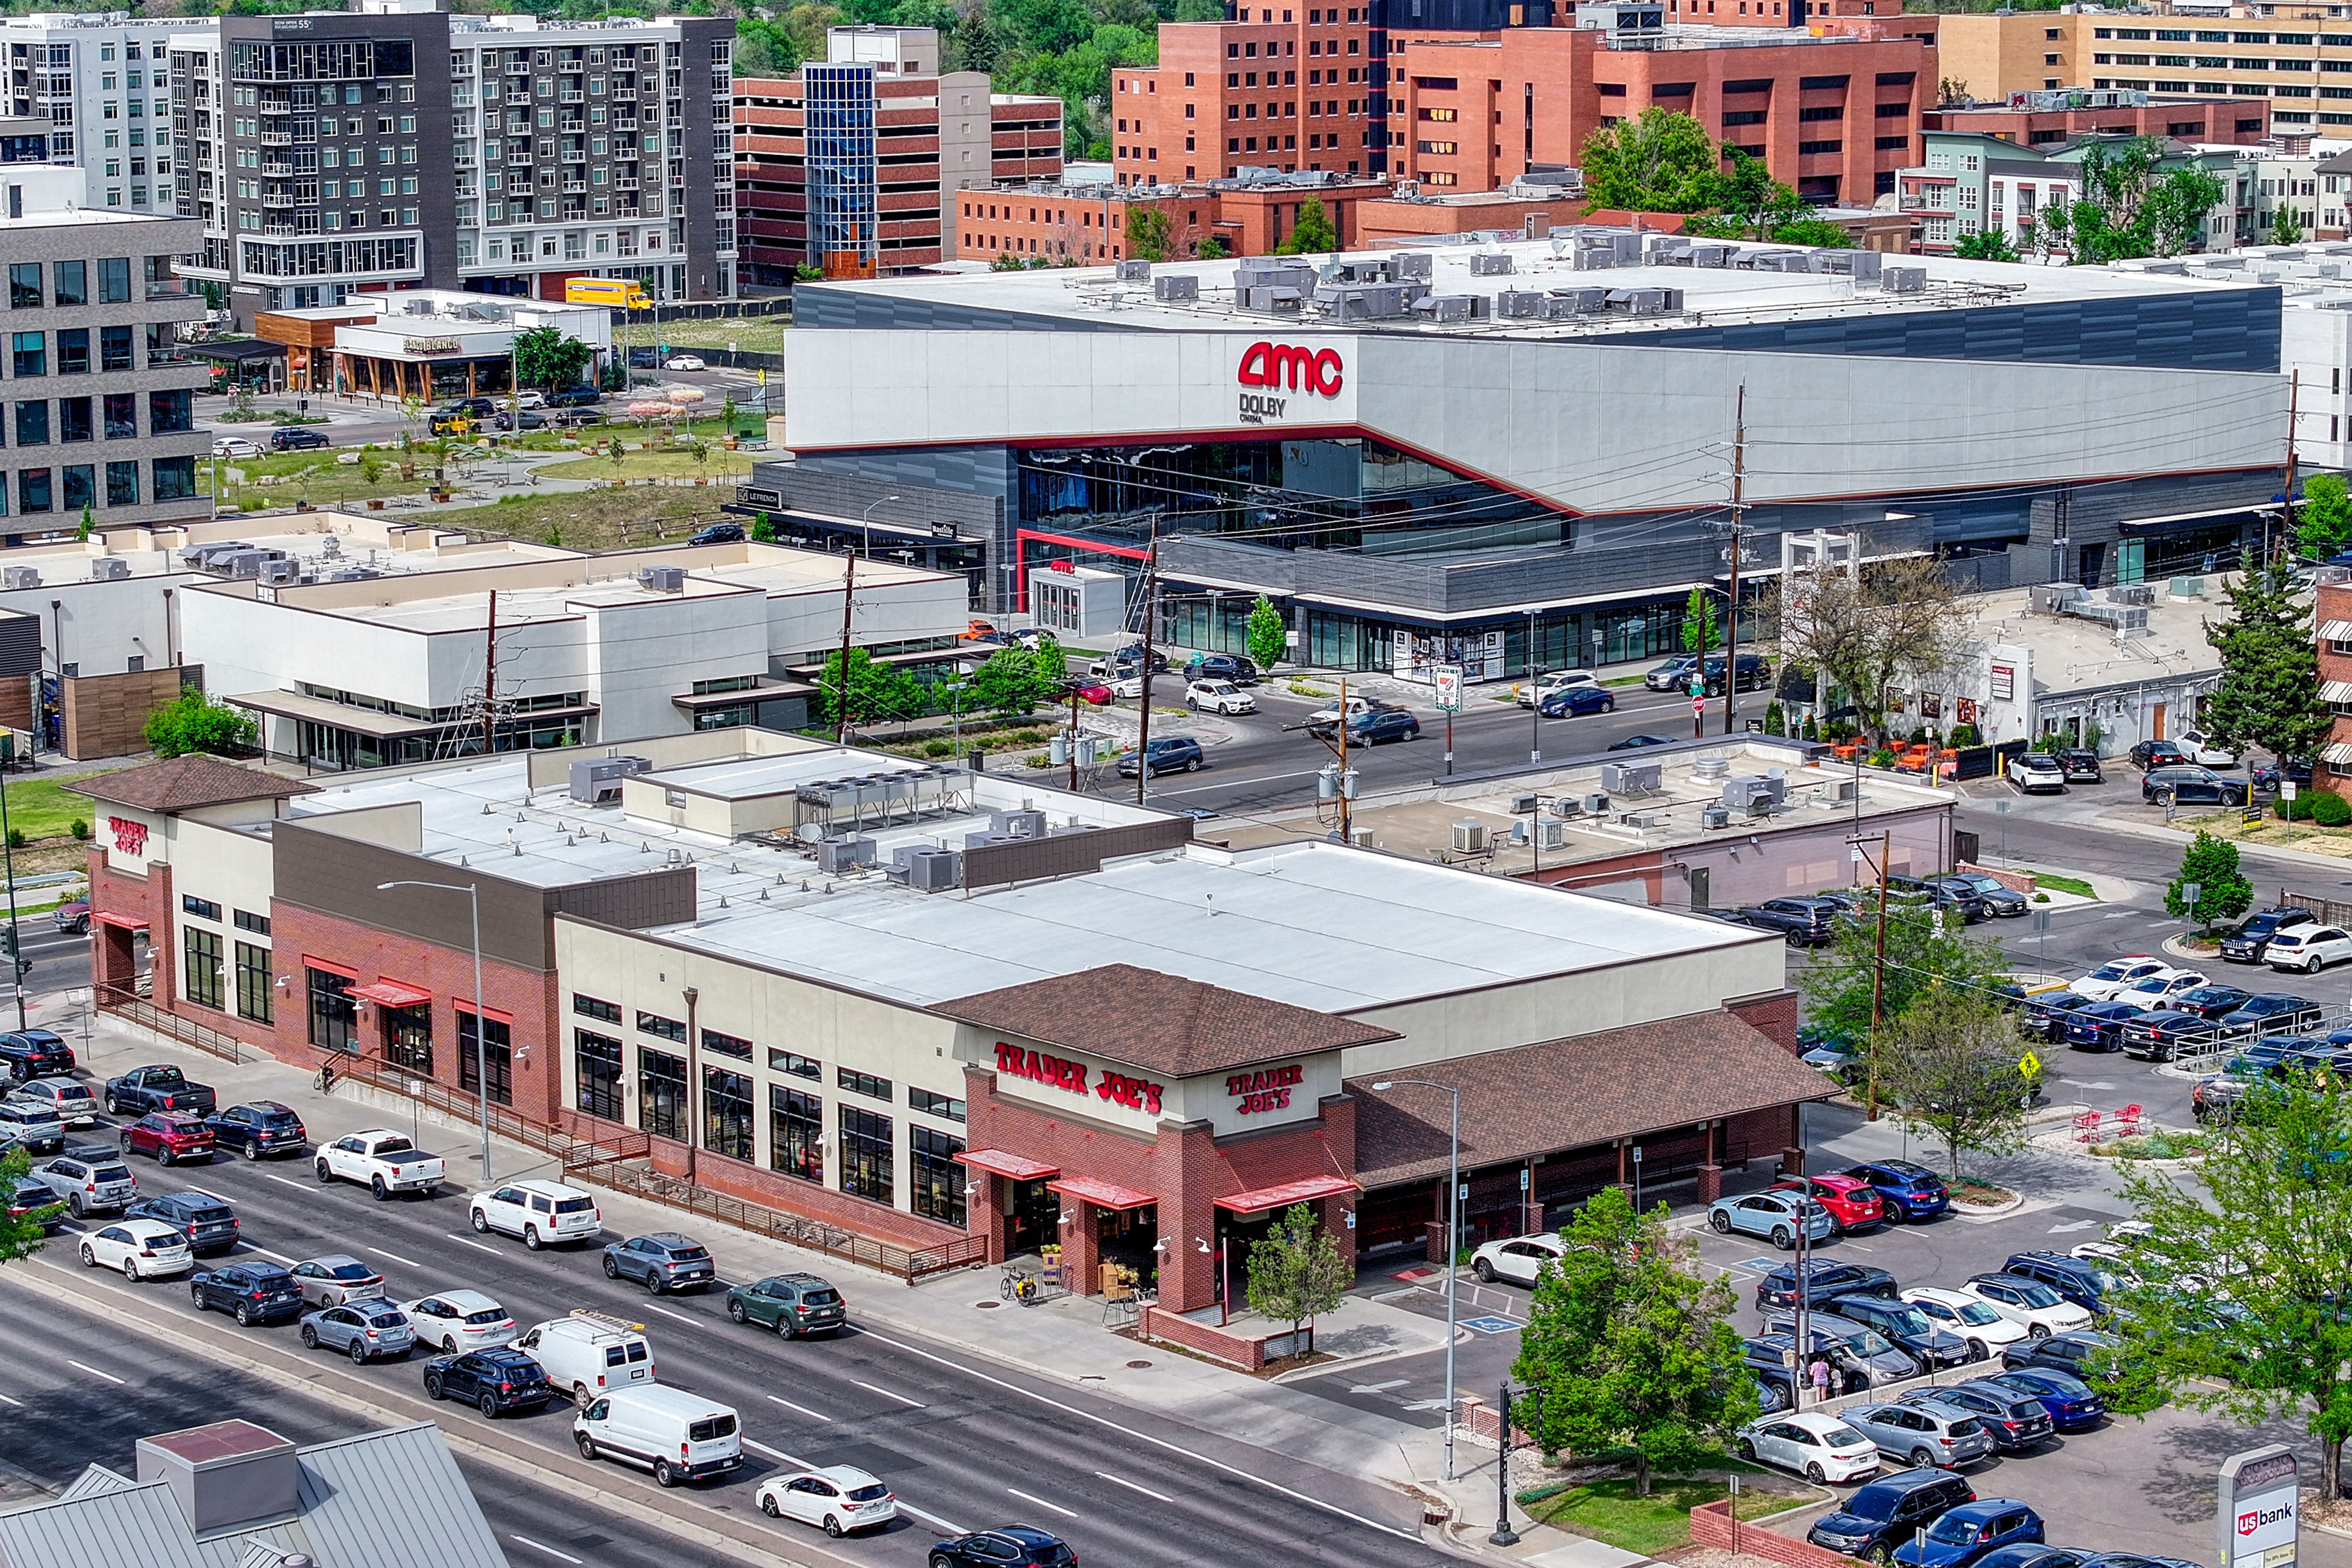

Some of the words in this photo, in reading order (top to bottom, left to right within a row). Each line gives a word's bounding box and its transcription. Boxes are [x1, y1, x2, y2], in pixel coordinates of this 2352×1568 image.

[426, 340, 458, 350] BLANCO
[1238, 341, 1343, 397] amc
[1239, 393, 1287, 418] DOLBY
[1240, 414, 1263, 425] CINEMA
[757, 494, 777, 503] FRENCH
[933, 524, 953, 535] Bastille
[108, 816, 149, 841] TRADER
[994, 1042, 1089, 1094] TRADER
[1095, 1070, 1164, 1114] JOE'S
[1225, 1064, 1303, 1096] TRADER
[1236, 1088, 1292, 1115] JOE'S
[2239, 1515, 2257, 1532] us
[2259, 1502, 2293, 1526] bank
